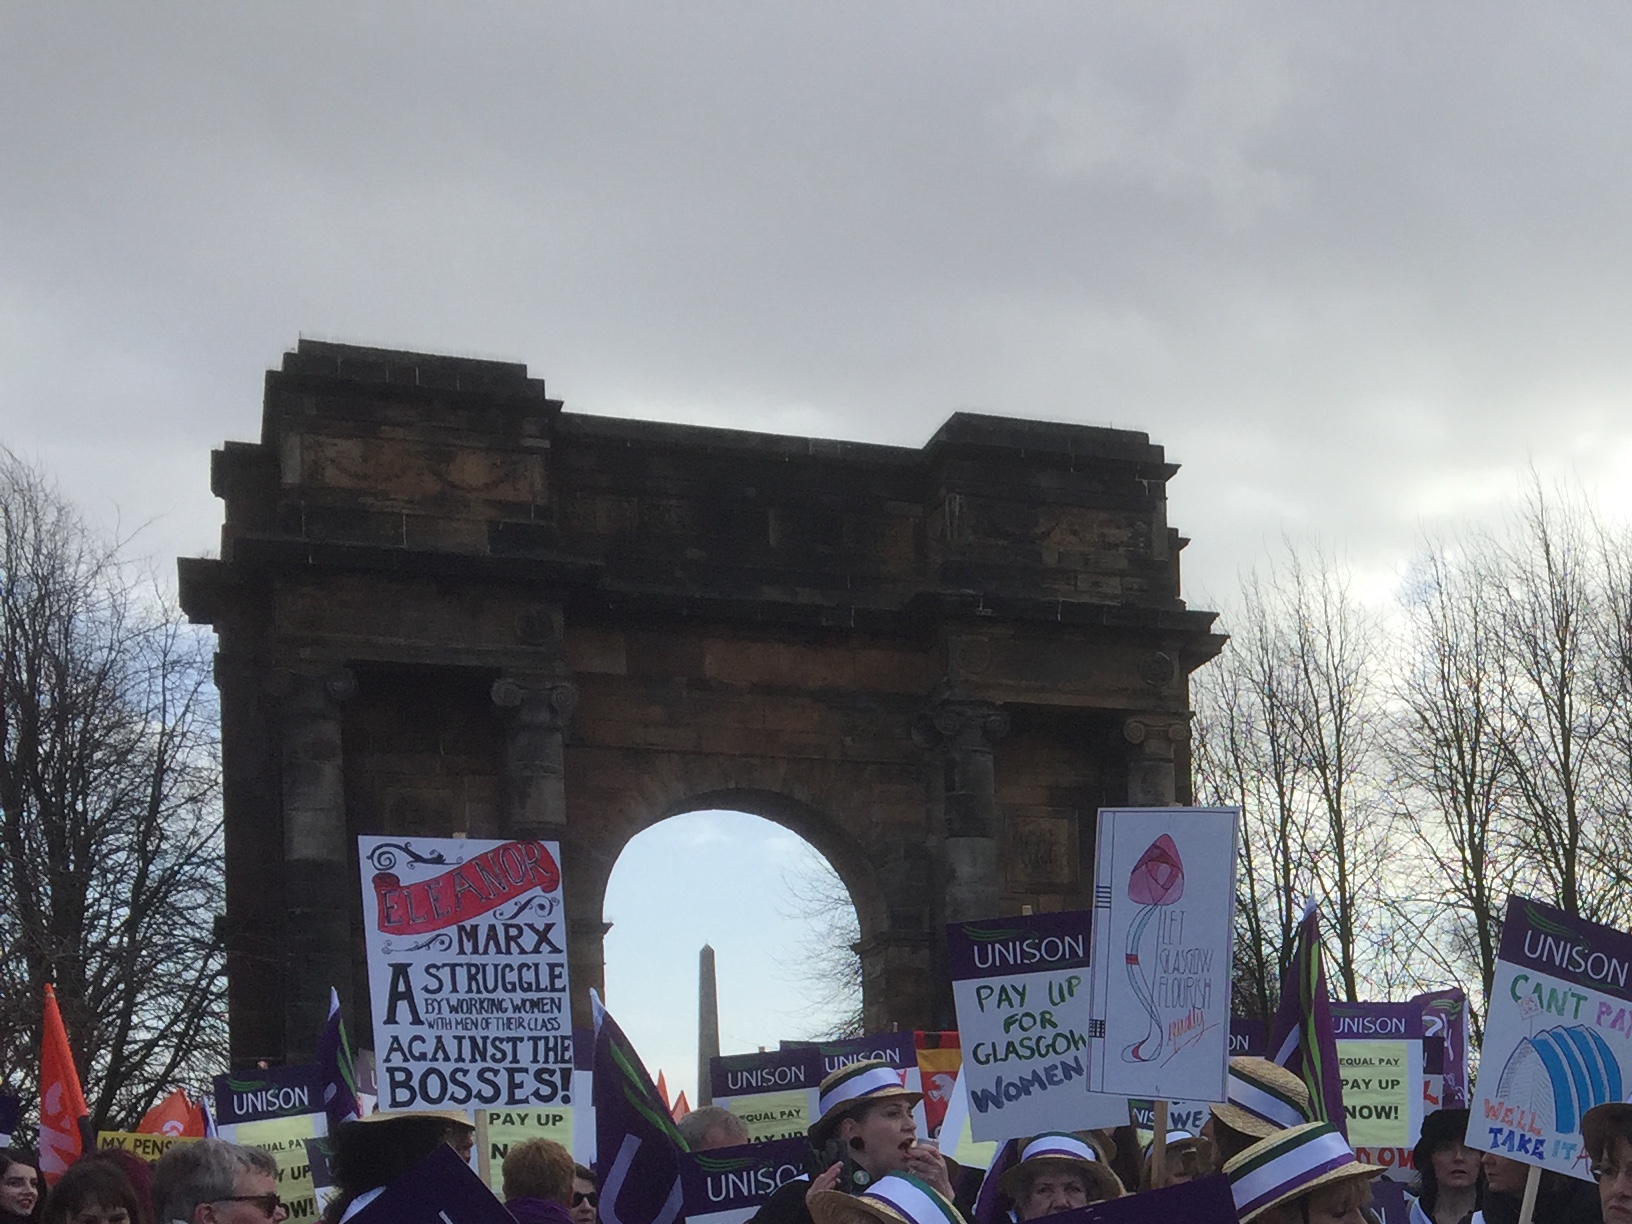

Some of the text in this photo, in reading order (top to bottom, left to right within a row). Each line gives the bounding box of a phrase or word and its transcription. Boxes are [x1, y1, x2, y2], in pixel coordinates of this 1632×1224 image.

[381, 842, 552, 927] ELEANOR
[456, 922, 564, 956] MARX
[1162, 910, 1187, 946] LET
[973, 934, 1084, 969] UNISON
[1159, 948, 1214, 975] GLASGOW
[1523, 929, 1629, 987] UNISON
[383, 962, 567, 1026] A STRUGGLE
[424, 997, 562, 1015] BY WORKING WOMEN
[975, 975, 1081, 1013] PAY UP
[1158, 976, 1212, 1010] FLOURISH
[425, 1016, 561, 1032] WITH MEN OF THEIR CLASS
[1003, 1010, 1059, 1034] FOR
[1332, 1016, 1406, 1034] UNISON
[382, 1034, 573, 1065] AGAINST THE
[1339, 1057, 1400, 1066] EQUAL PAY
[386, 1066, 572, 1109] BOSSES!
[728, 1065, 805, 1089] UNISON
[970, 1055, 1085, 1114] WOMEN
[1342, 1078, 1400, 1090] PAY UP
[233, 1085, 310, 1115] UNISON
[780, 1108, 802, 1119] PAY
[1345, 1105, 1399, 1120] NOW!
[489, 1113, 564, 1127] PAY UP
[101, 1137, 128, 1151] MY
[1488, 1127, 1578, 1160] TAKE IT
